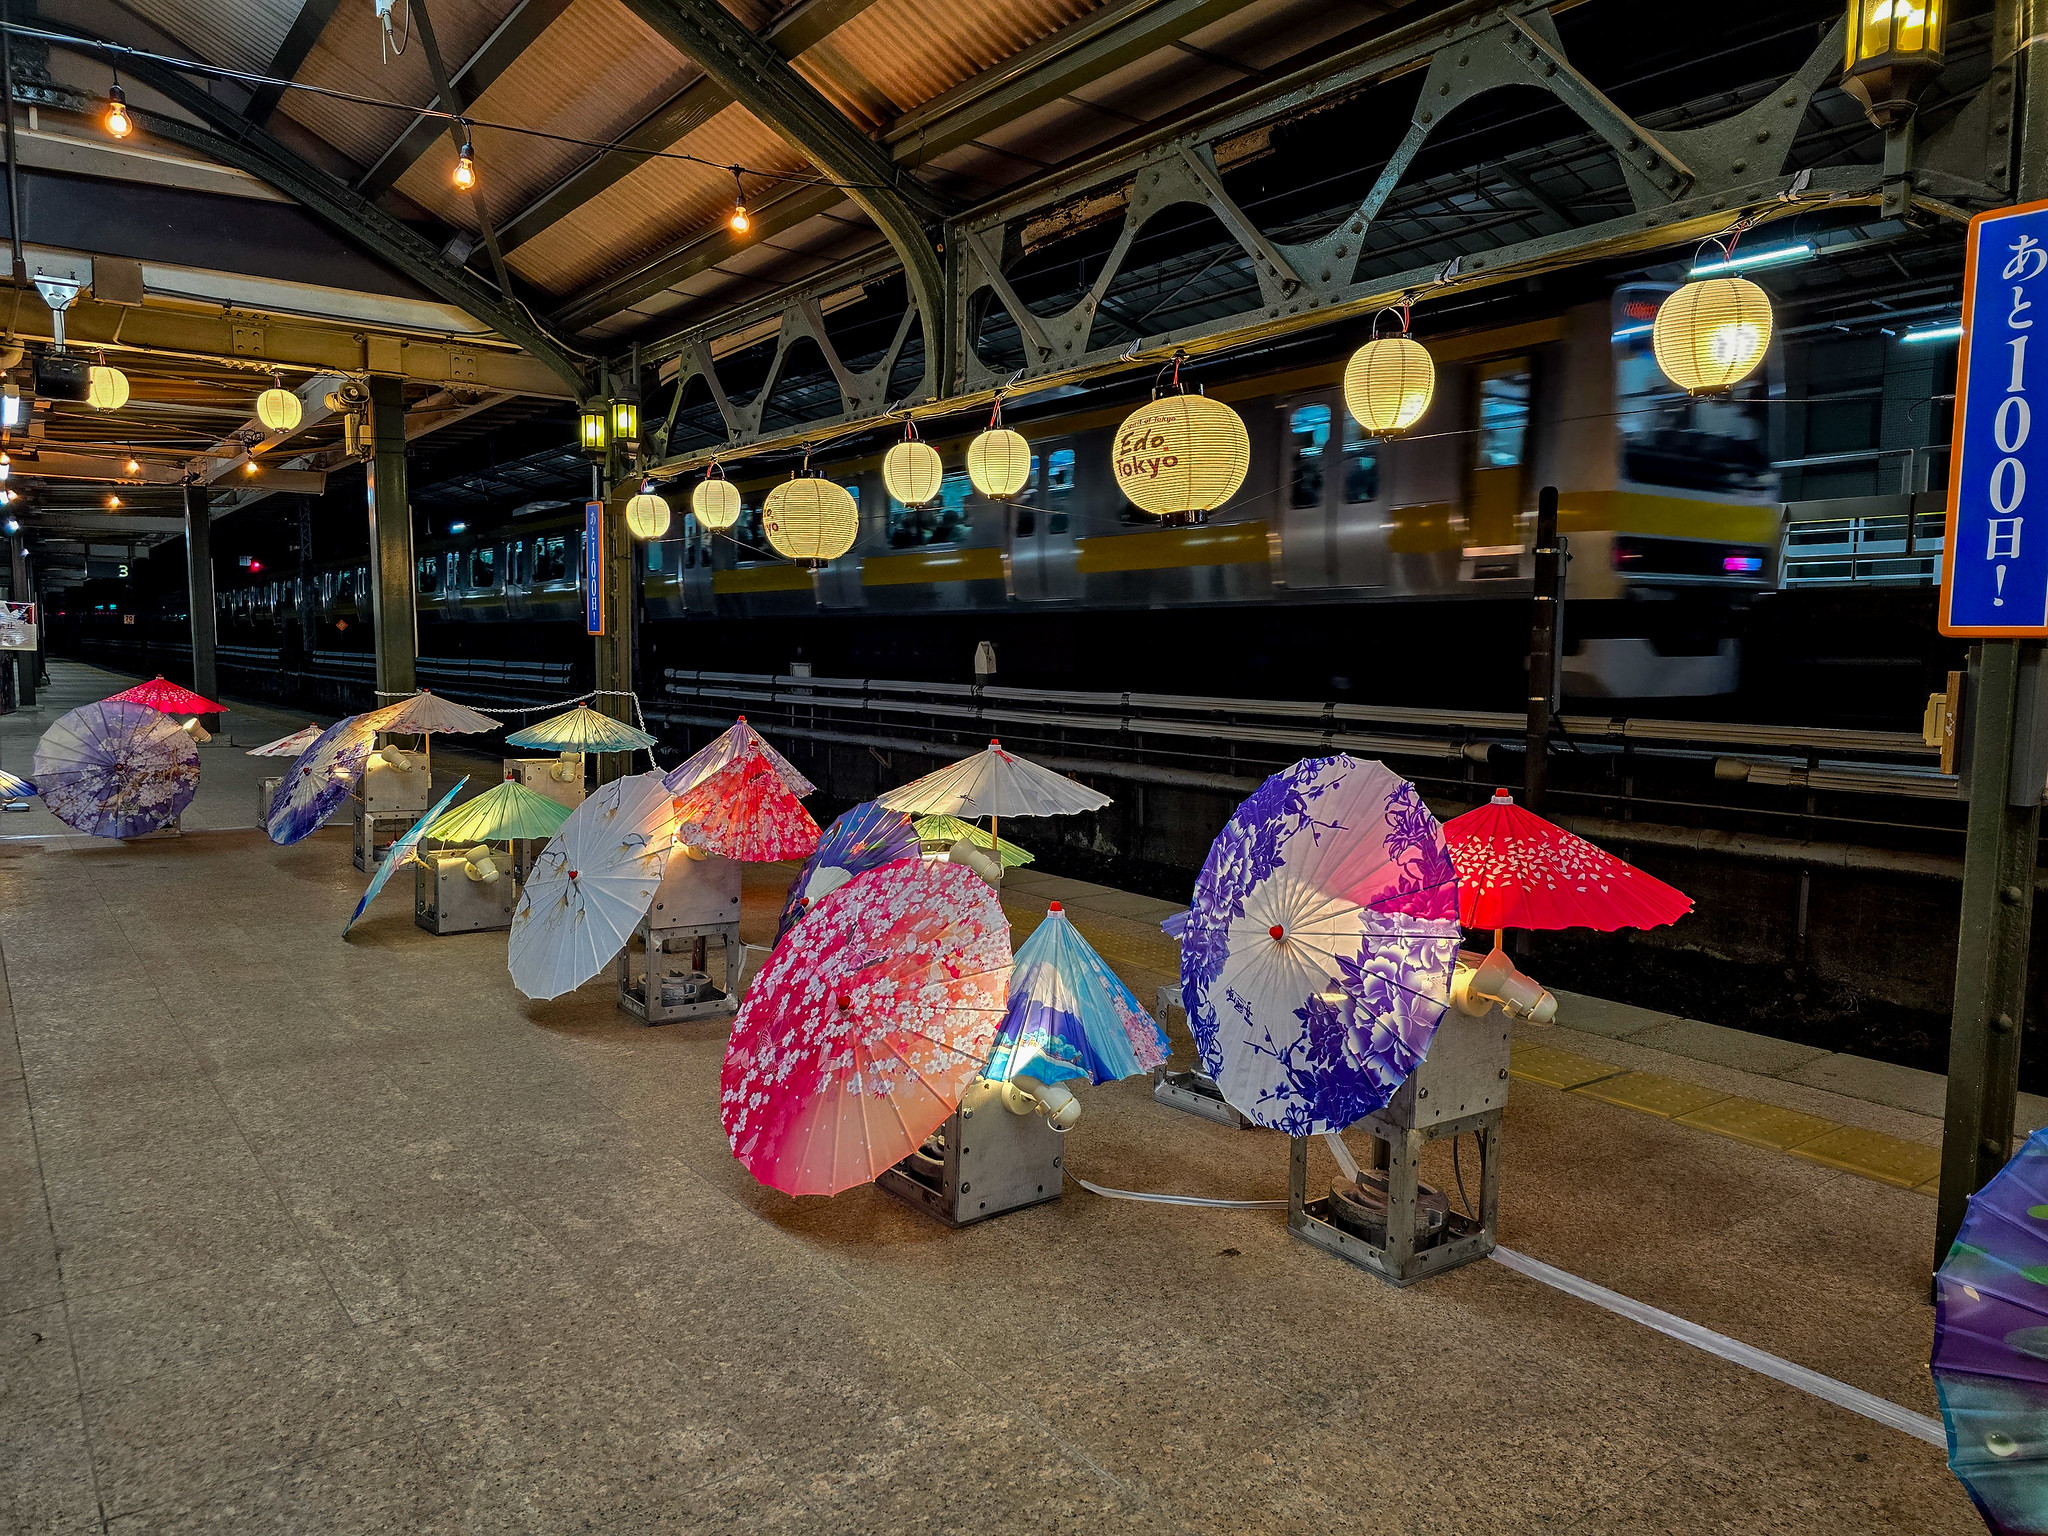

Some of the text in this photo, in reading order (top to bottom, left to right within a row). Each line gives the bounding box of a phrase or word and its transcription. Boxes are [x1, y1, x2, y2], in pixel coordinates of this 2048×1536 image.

[1986, 234, 2048, 608] あと100日!
[1116, 455, 1179, 479] Tokyo
[118, 564, 129, 578] 3
